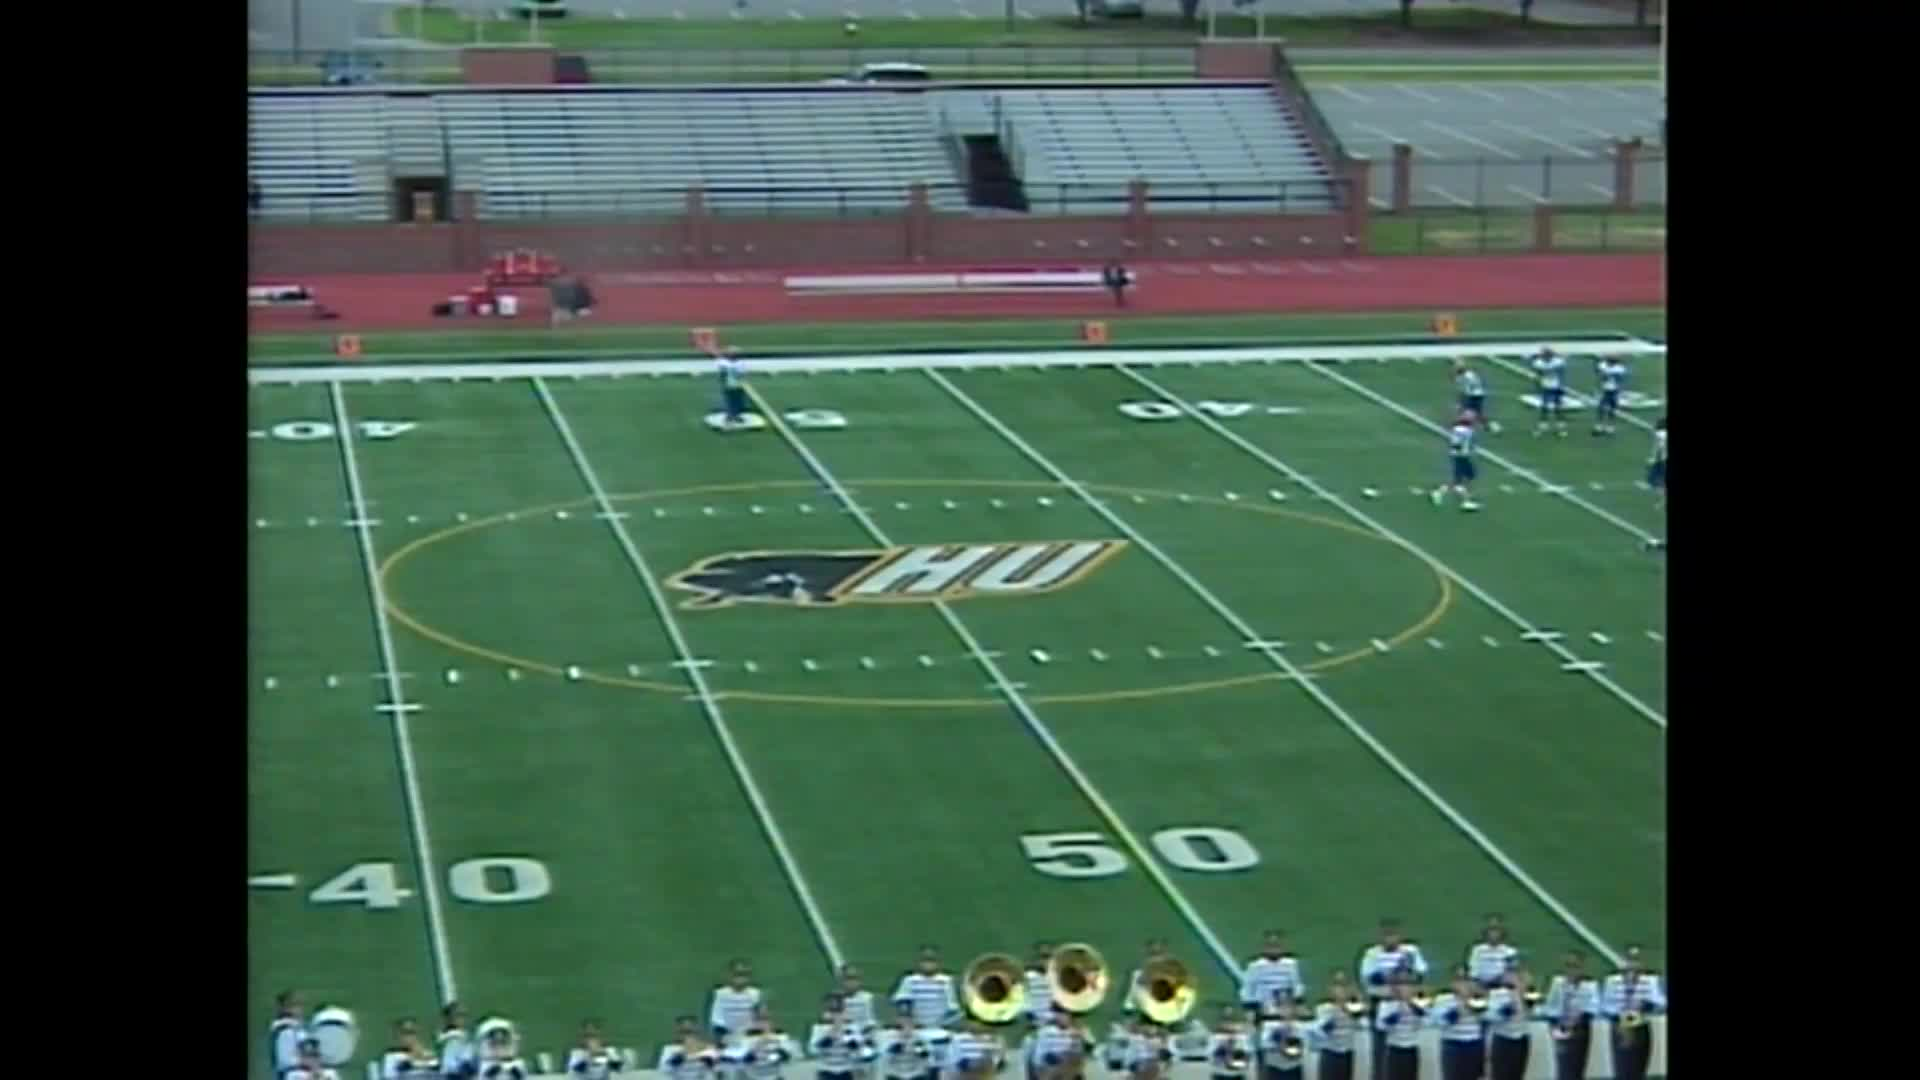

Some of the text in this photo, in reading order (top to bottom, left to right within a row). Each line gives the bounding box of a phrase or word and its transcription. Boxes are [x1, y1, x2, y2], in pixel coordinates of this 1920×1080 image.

[842, 541, 1122, 597] HU
[1019, 826, 1260, 877] 50
[308, 857, 552, 909] 40
